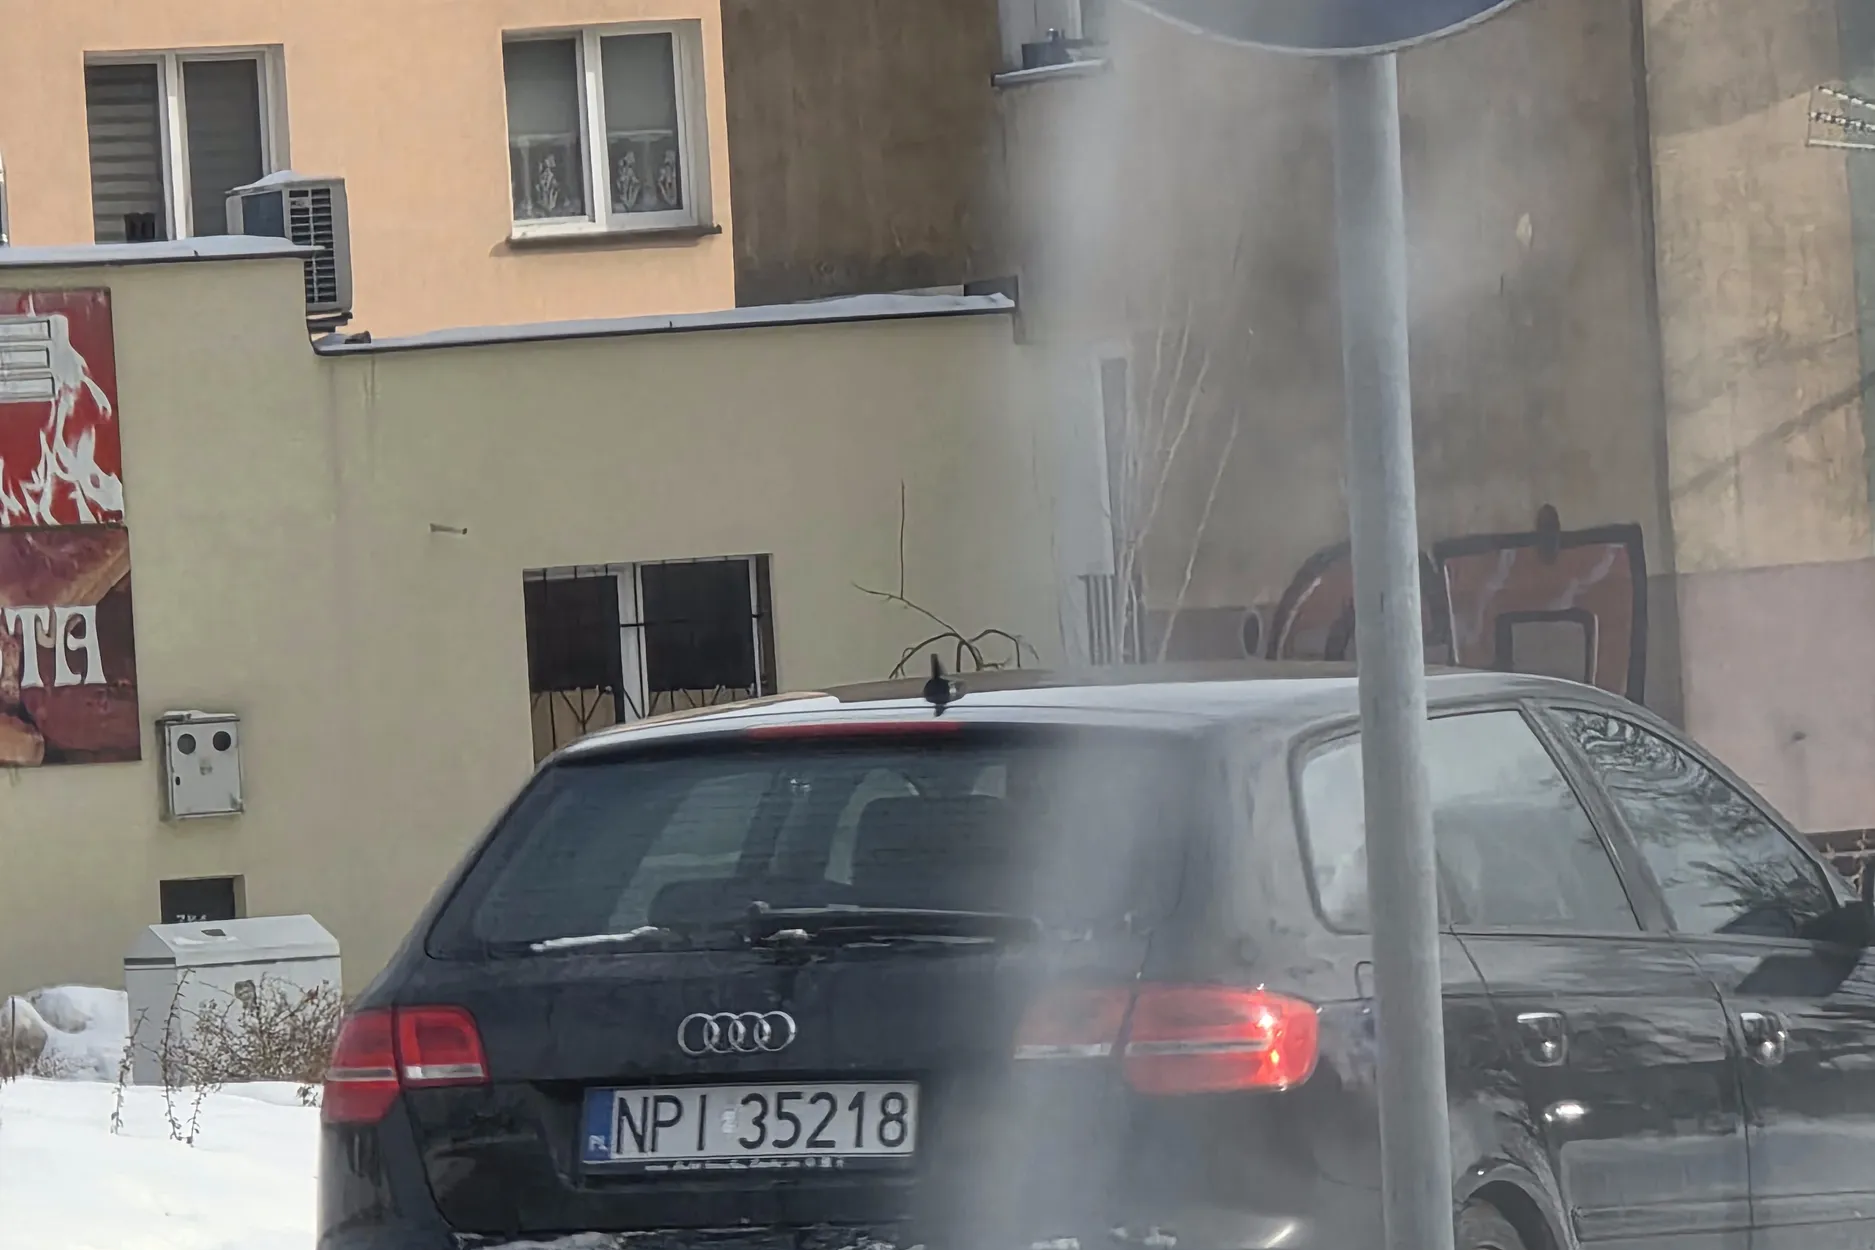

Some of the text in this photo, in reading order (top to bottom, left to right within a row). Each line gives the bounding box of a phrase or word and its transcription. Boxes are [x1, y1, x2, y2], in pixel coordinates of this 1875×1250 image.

[0, 605, 107, 688] TA
[616, 1091, 909, 1155] NPI 35218
